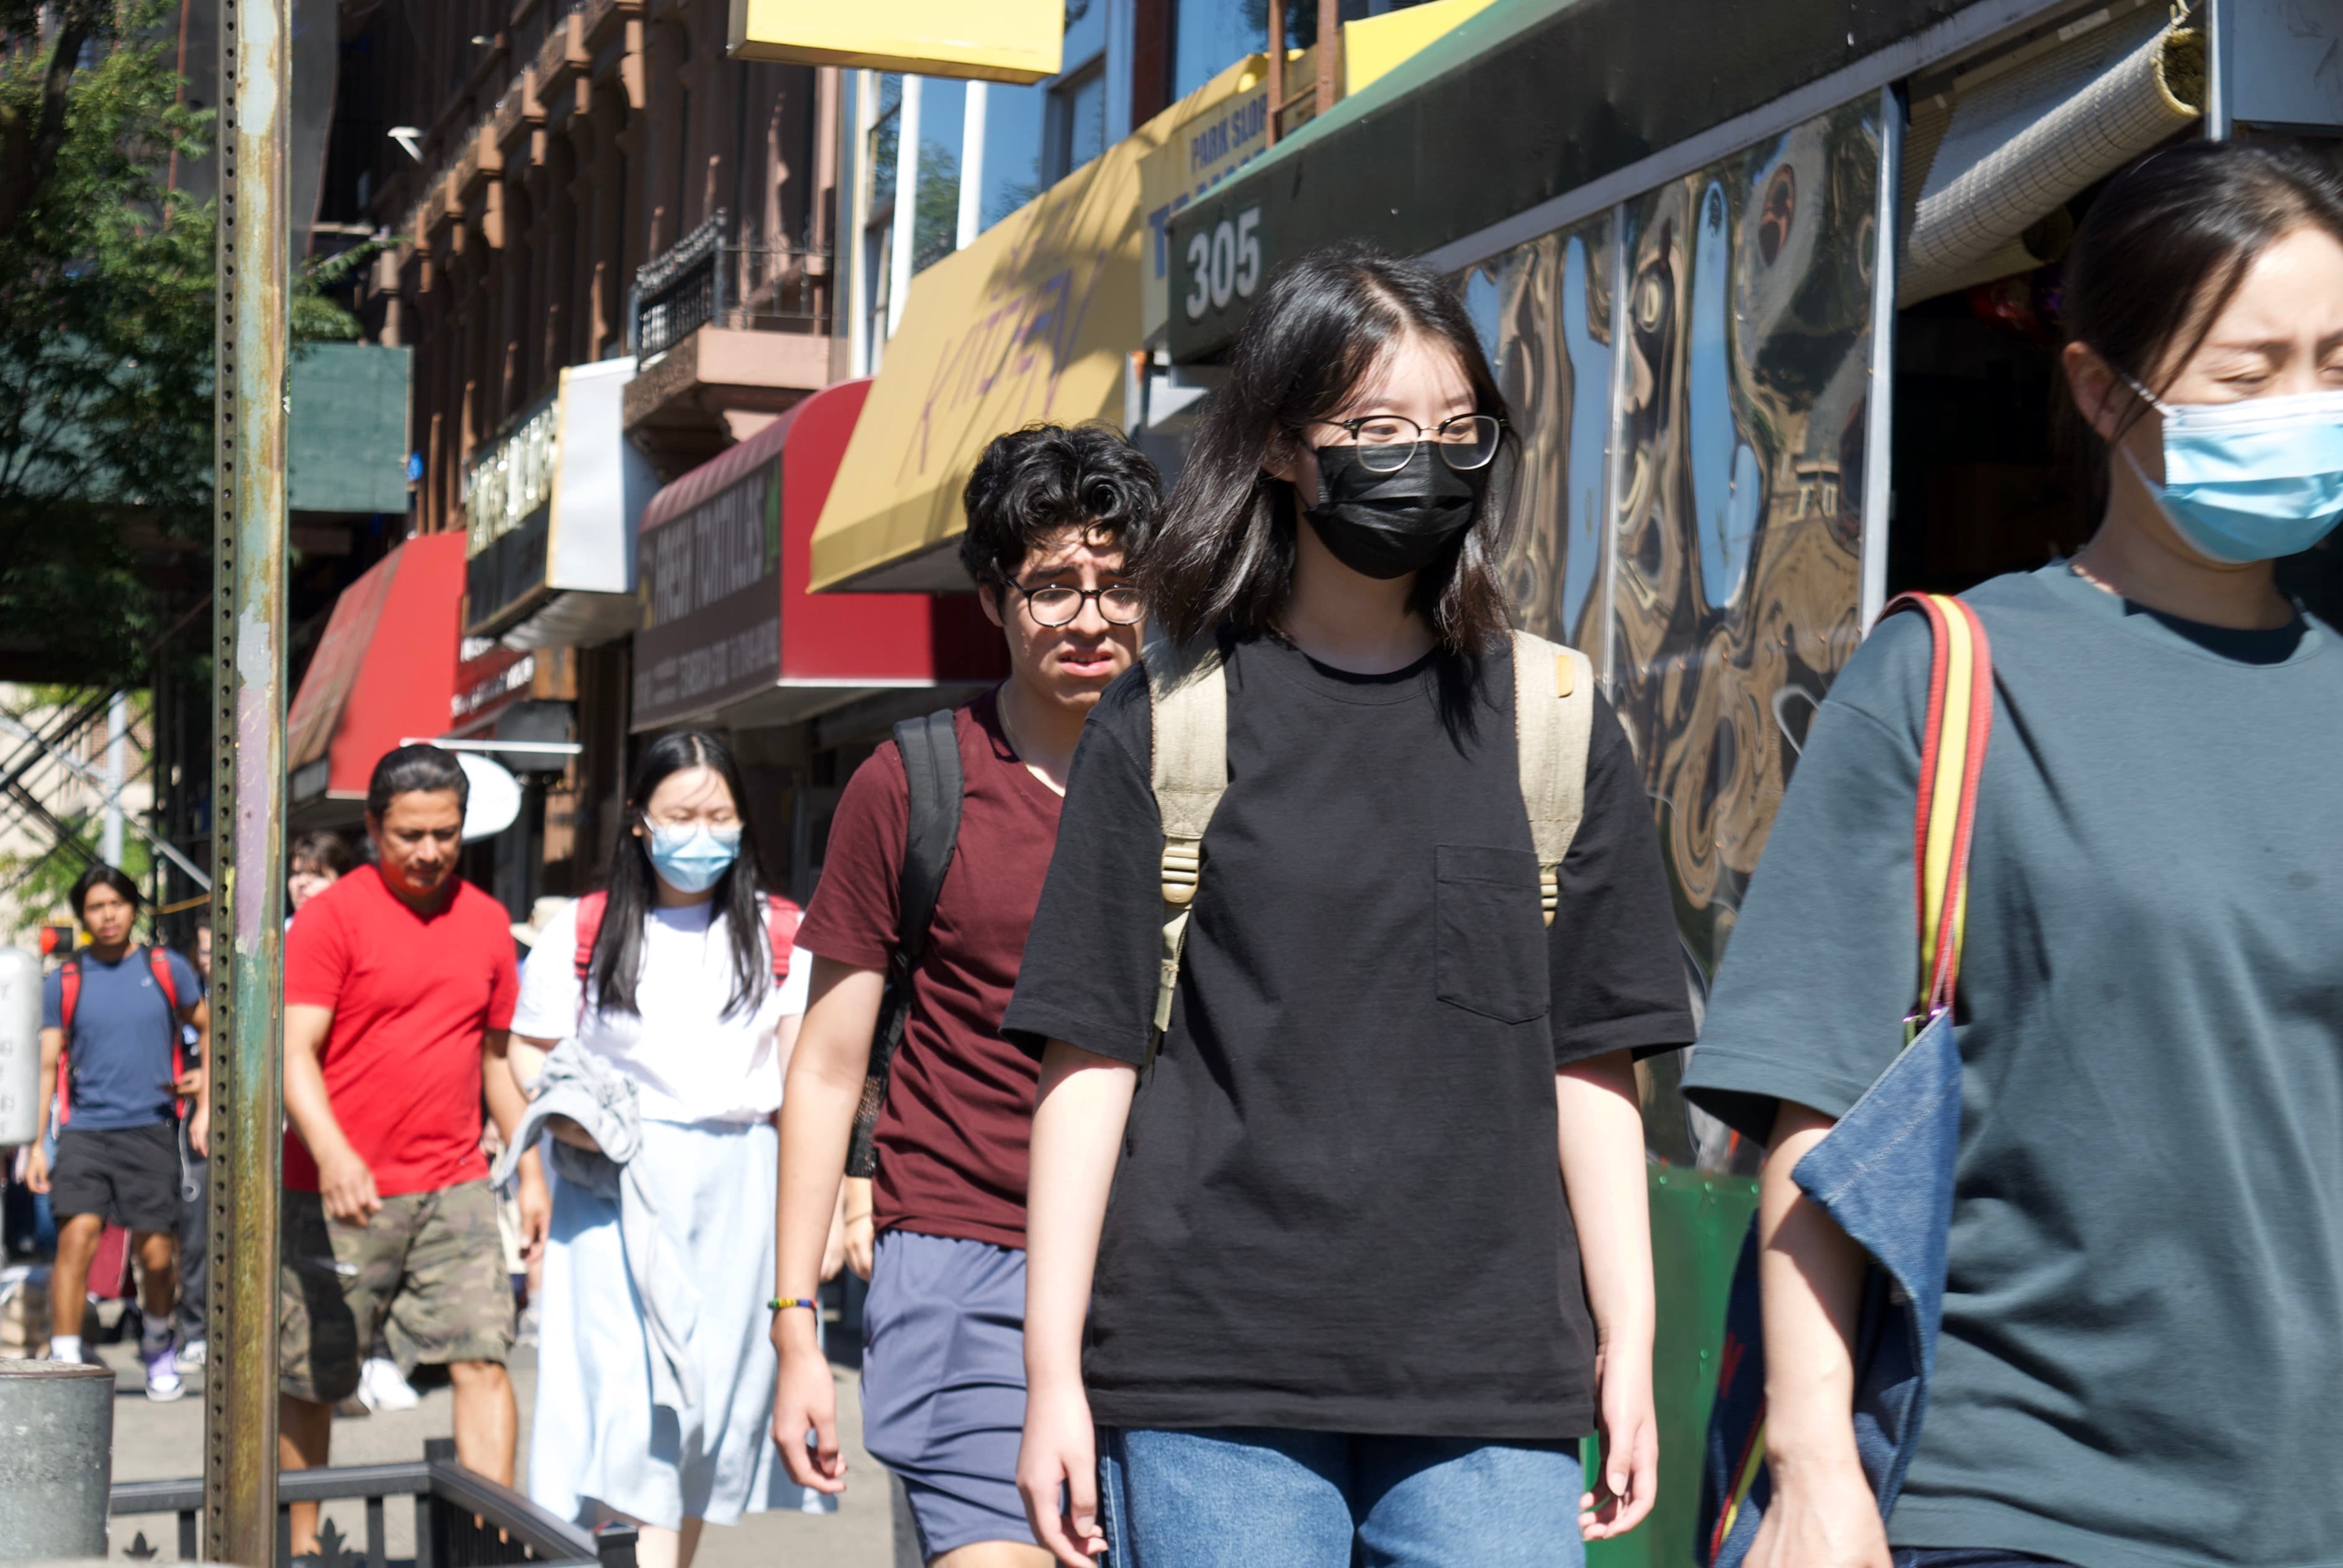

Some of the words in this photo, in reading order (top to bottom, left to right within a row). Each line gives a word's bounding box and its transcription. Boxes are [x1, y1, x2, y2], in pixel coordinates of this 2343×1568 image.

[1190, 117, 1229, 174] PARK
[1231, 91, 1268, 149] SLOP
[1186, 207, 1261, 318] 305
